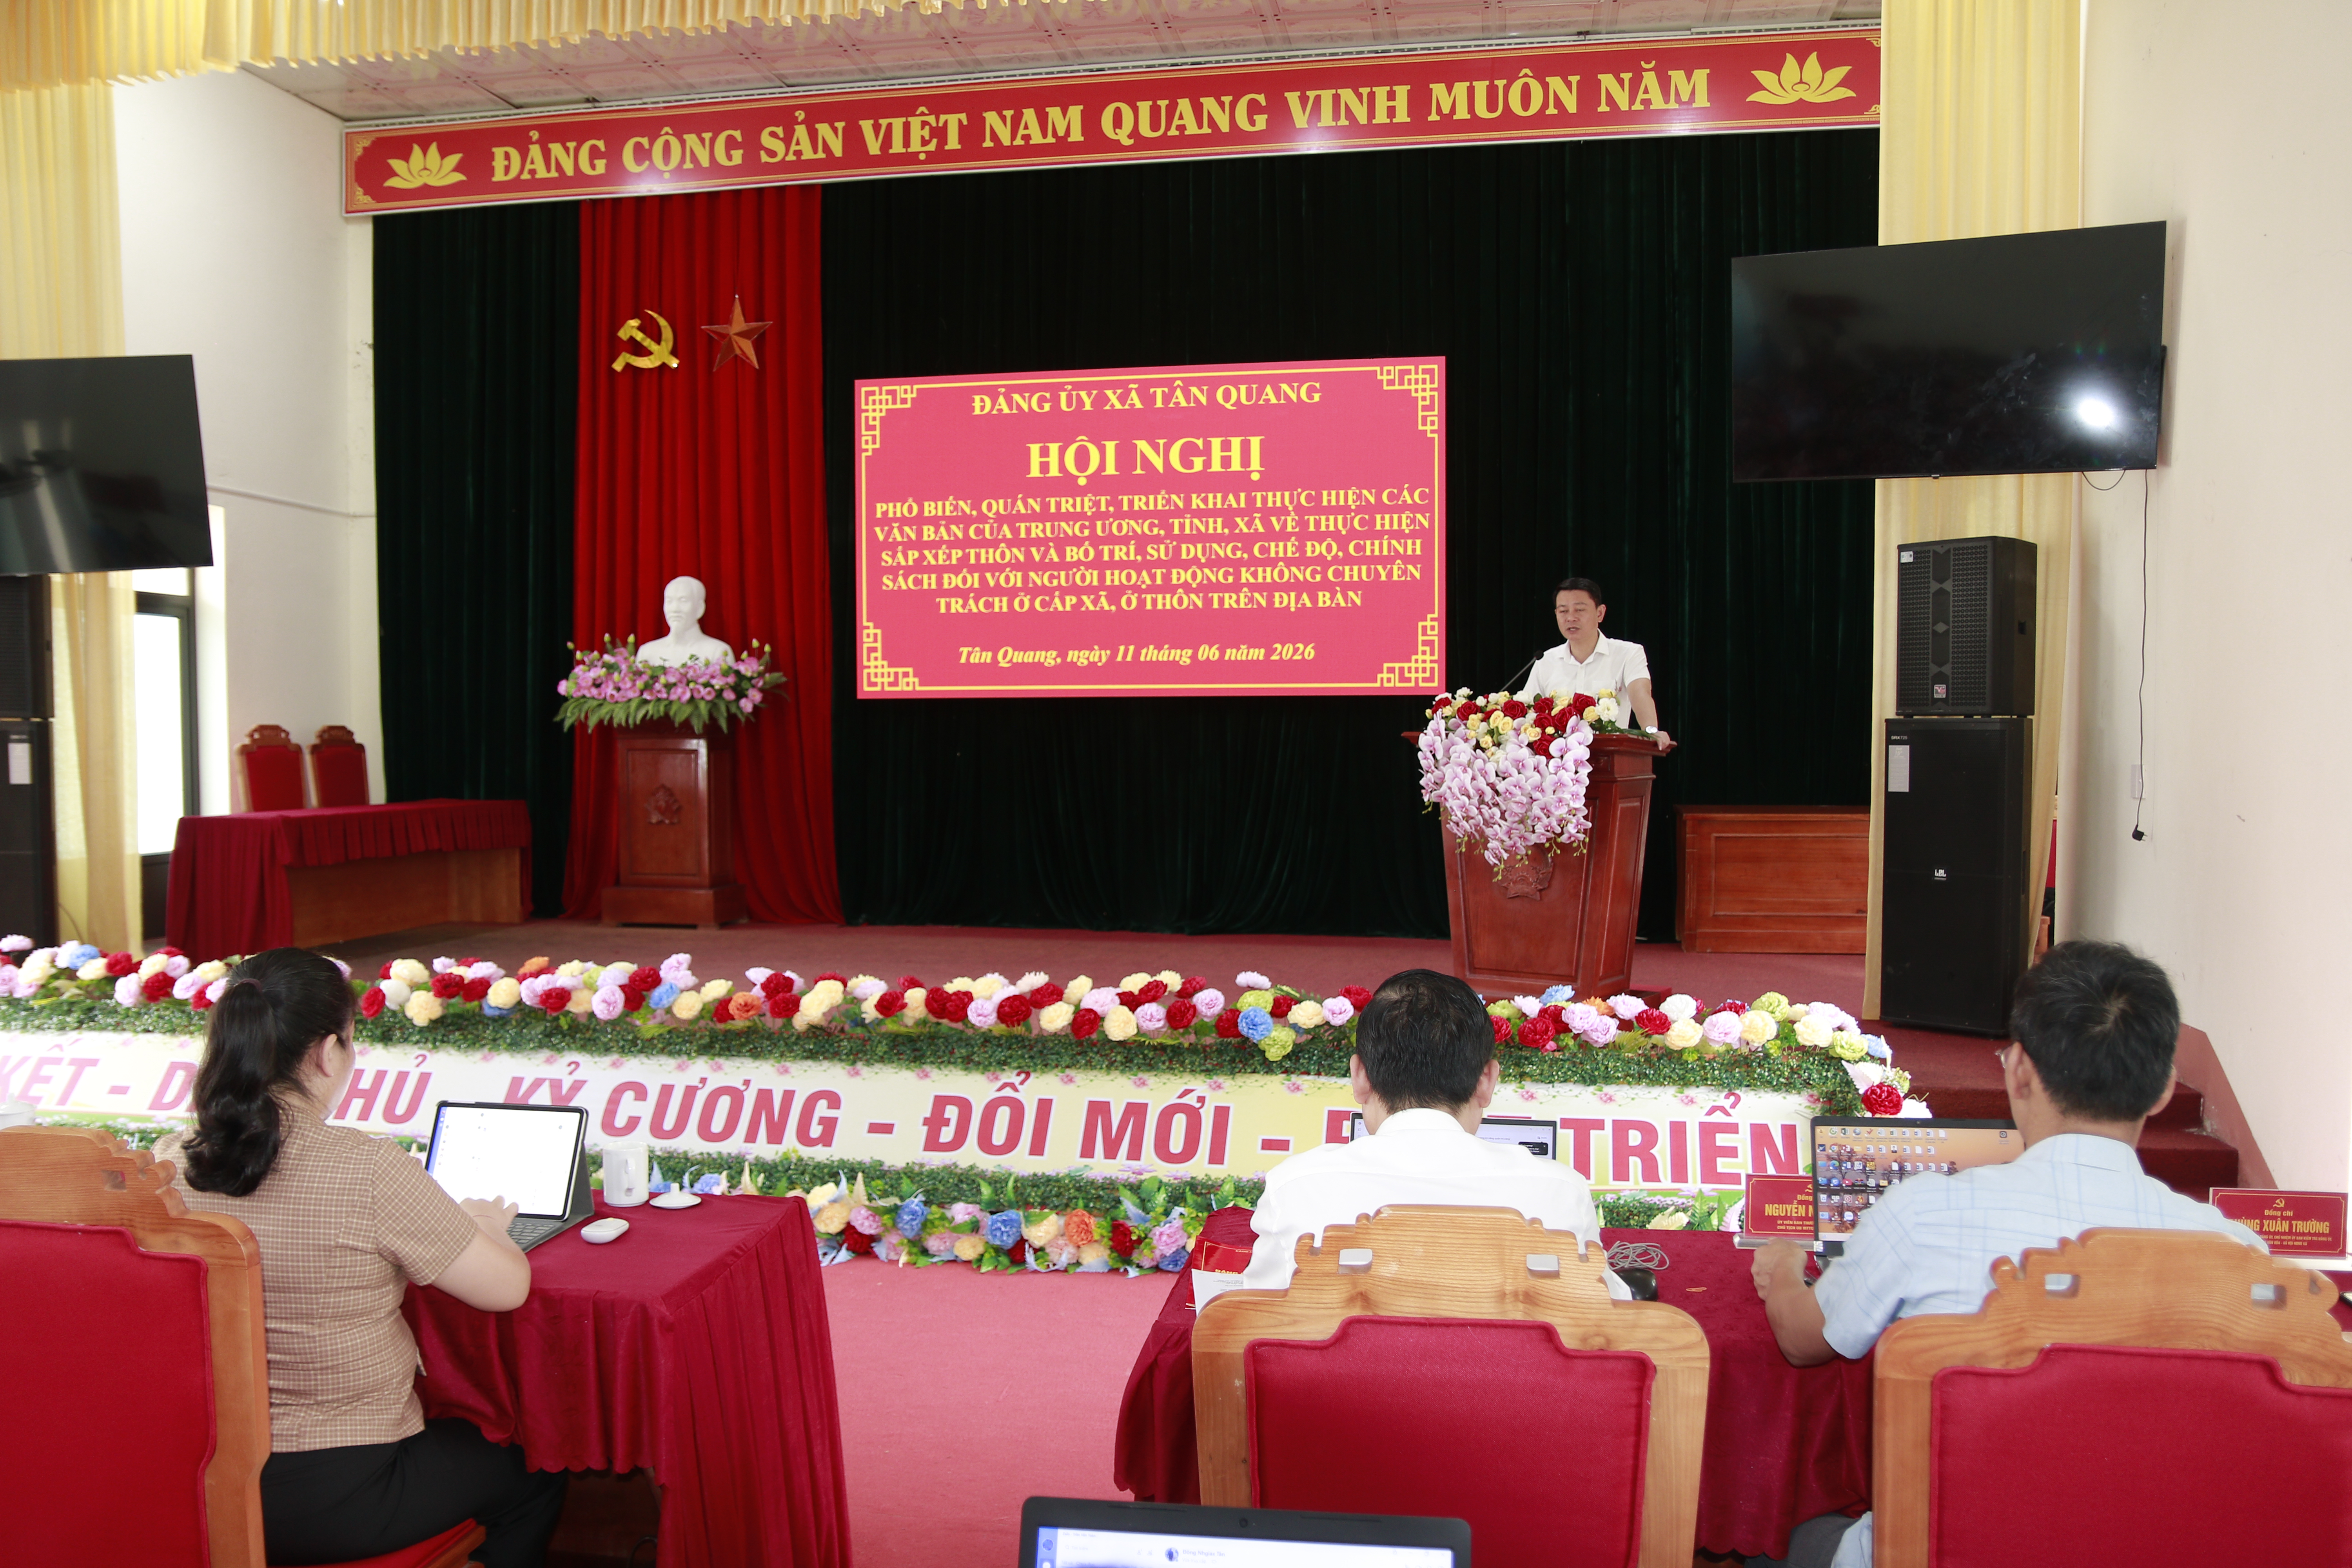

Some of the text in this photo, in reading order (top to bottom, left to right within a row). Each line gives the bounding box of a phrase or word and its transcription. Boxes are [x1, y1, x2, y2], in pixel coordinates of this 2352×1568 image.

[491, 60, 1711, 181] ĐẢNG CỘNG SẢN VIỆT NAM QUANG VINH MUÔN NĂM
[971, 379, 1322, 415] ĐẢNG ỦY XÃ TÂN QUANG
[1025, 435, 1265, 486] HỘI NGHỊ
[876, 483, 1429, 518] PHỔ BIẾN, QUÁN TRIỆT, TRIỂN KHAI THỰC HIỆN CÁC
[874, 510, 1430, 542] VĂN BẢN CỦA TRUNG ƯƠNG, TỈNH, XÃ VỀ THỰC HIỆN
[881, 534, 1422, 567] SẮP XẾP THÔN VÀ BỐ TRÍ, SỬ DỤNG, CHẾ ĐỘ, CHÍNH
[882, 559, 1421, 591] SÁCH ĐỐI VỚI NGƯỜI HOẠT ĐỘNG KHÔNG CHUYÊN
[935, 586, 1362, 614] TRÁCH Ở CẤP XÃ, Ở THÔN TRÊN ĐỊA BÀN
[959, 642, 1316, 668] Tân Quang, ngày 11 tháng 06 năm 2026
[334, 1054, 432, 1124] HỦ
[601, 1077, 842, 1147] CƯƠNG
[922, 1071, 1054, 1156] ĐỔI
[1080, 1088, 1230, 1165] MỚI
[1559, 1092, 1799, 1185] TRIỂN
[1765, 1200, 1806, 1217] NGUYỄN
[2262, 1218, 2289, 1232] XUÂN
[2292, 1218, 2330, 1234] TRƯỜNG
